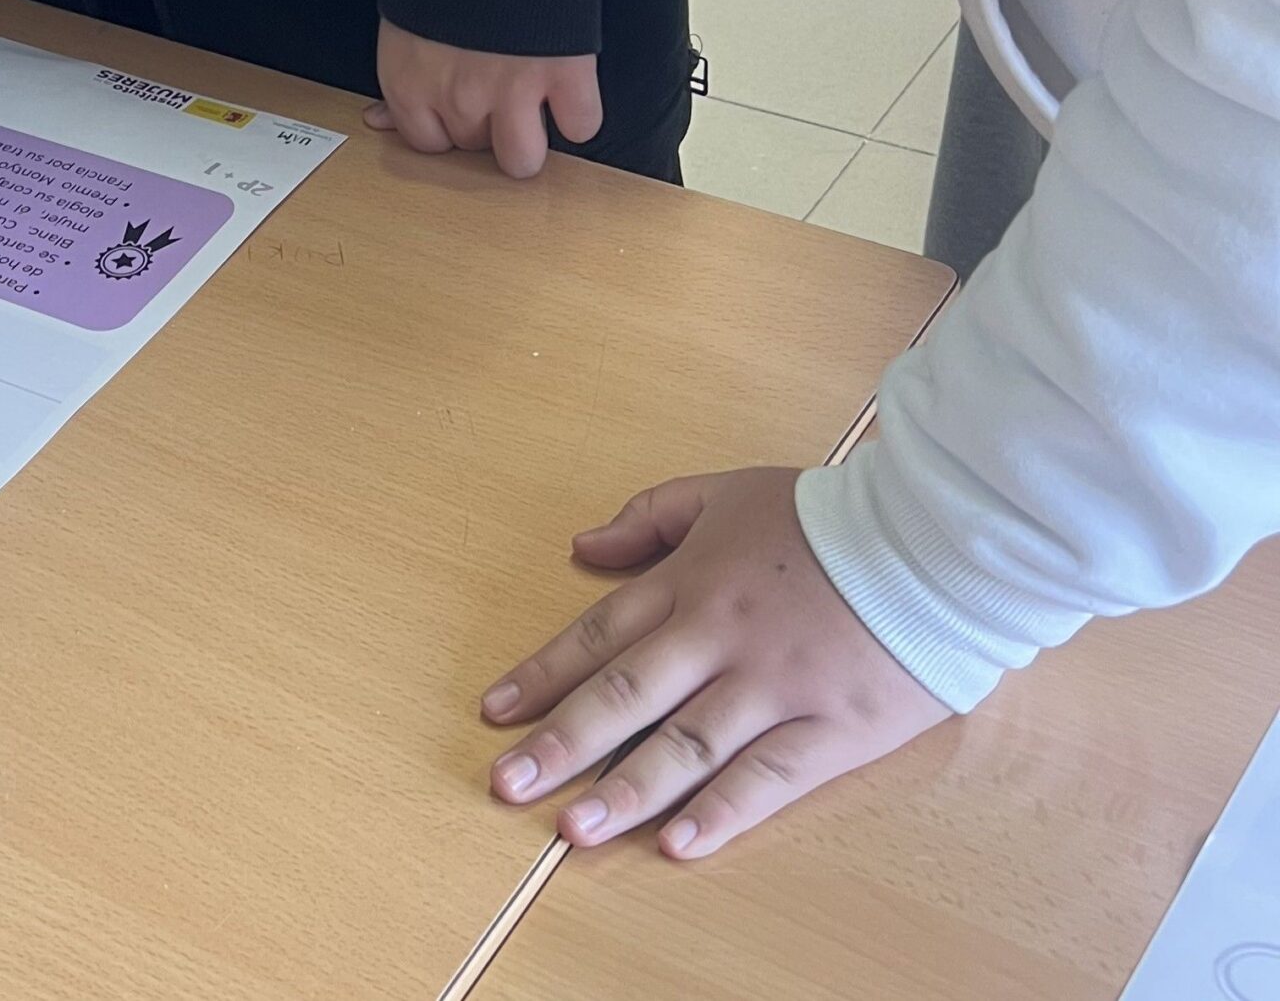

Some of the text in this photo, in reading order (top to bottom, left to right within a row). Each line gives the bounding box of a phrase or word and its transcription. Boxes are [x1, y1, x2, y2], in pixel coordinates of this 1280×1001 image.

[96, 69, 193, 103] MUJERES
[112, 83, 187, 109] Instituto
[24, 151, 45, 162] su
[44, 158, 76, 171] por
[74, 166, 133, 192] Francia
[33, 191, 55, 202] su
[60, 181, 119, 206] Premio
[12, 203, 31, 214] él
[55, 197, 104, 218] elogia
[39, 209, 90, 233] mujer,
[28, 225, 75, 249] Blanc.
[38, 250, 60, 263] Se
[21, 264, 44, 277] de
